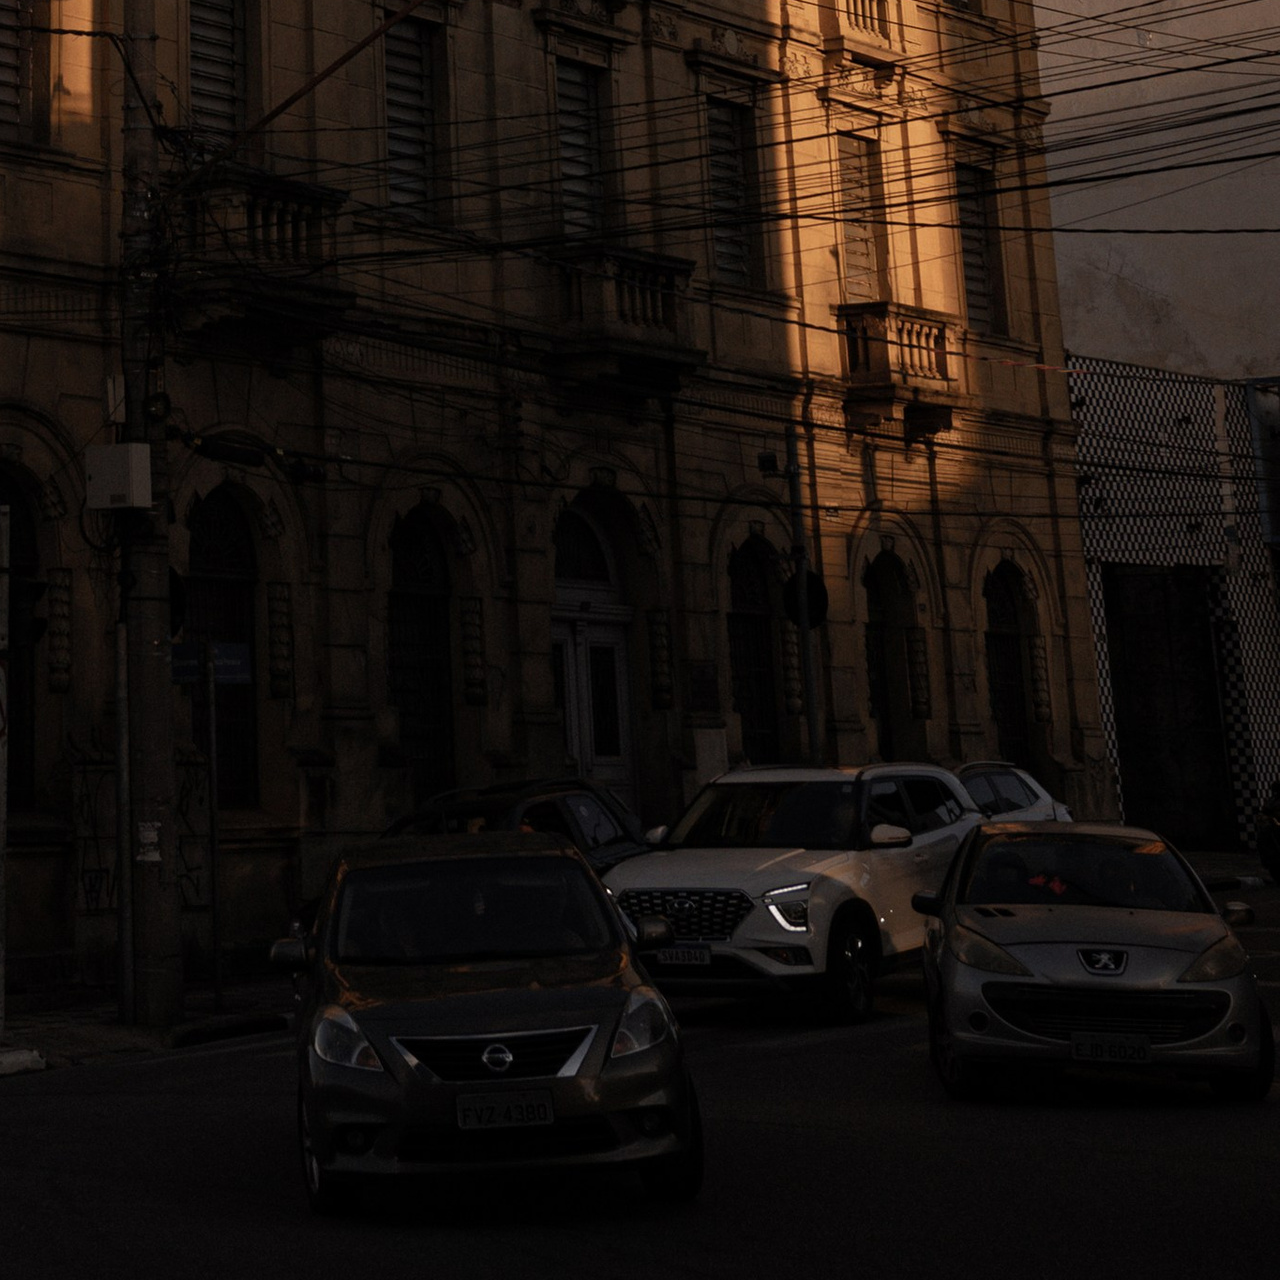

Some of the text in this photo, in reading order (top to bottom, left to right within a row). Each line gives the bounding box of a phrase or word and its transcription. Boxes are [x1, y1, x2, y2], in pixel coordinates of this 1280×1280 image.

[1108, 1044, 1147, 1060] 6020
[462, 1102, 548, 1126] FVZ 4380
